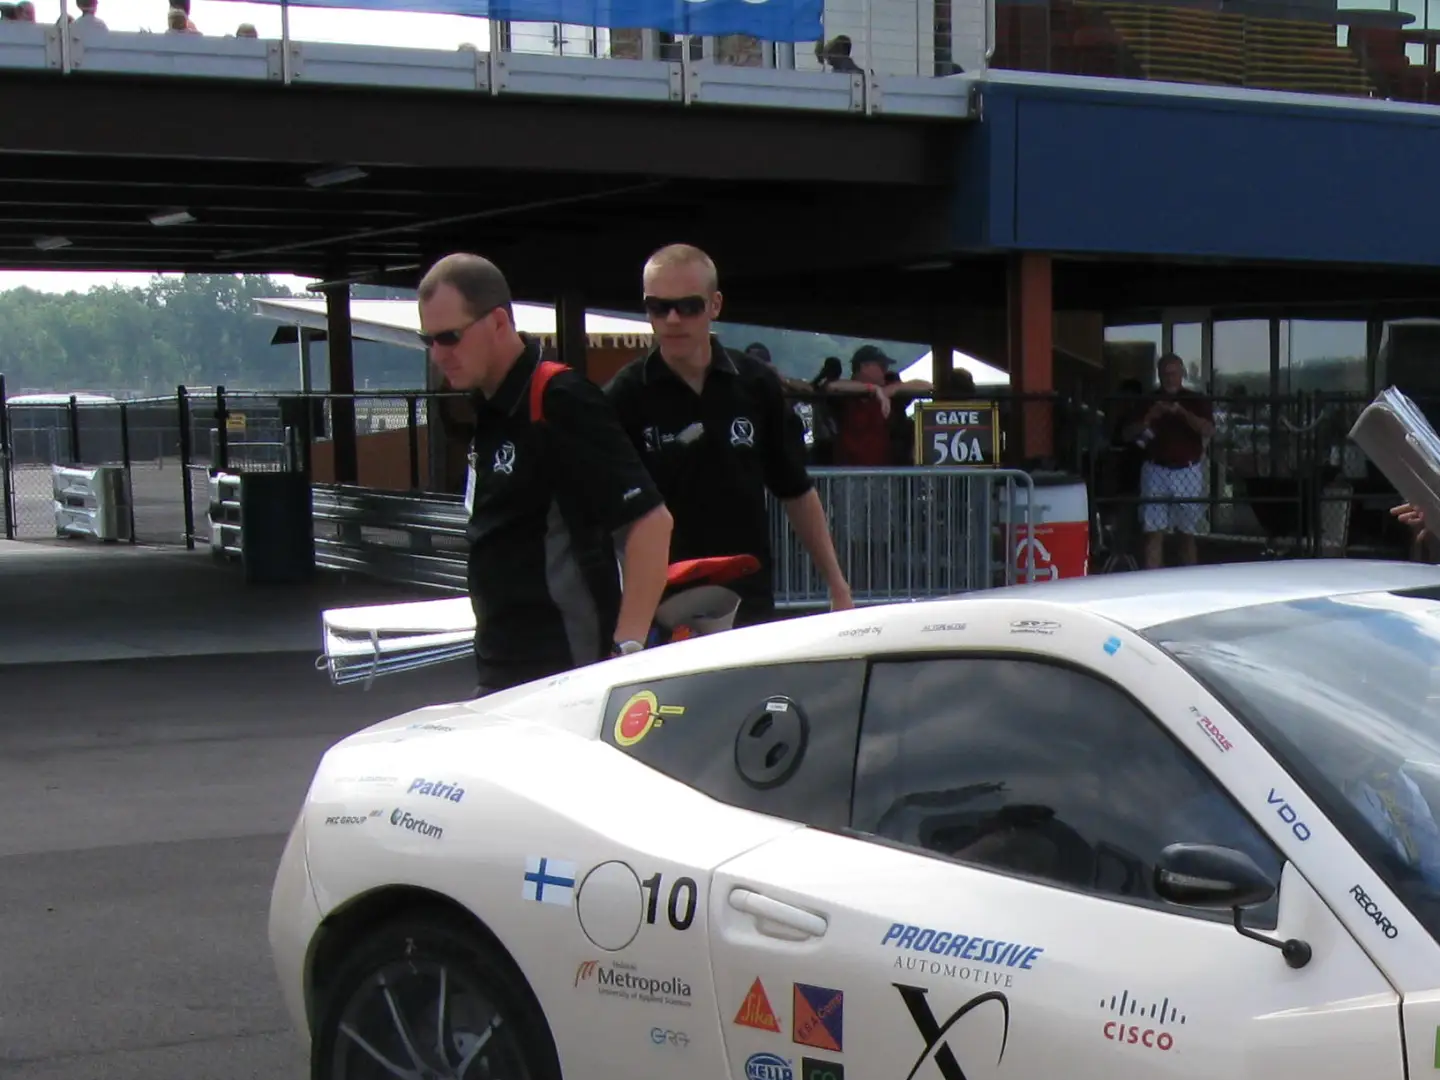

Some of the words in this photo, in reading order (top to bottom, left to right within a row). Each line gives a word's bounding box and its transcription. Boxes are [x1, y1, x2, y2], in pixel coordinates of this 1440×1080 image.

[935, 411, 979, 424] GATE
[934, 429, 984, 465] 56A
[407, 777, 466, 804] Patria
[399, 811, 444, 840] Fortum
[1266, 788, 1312, 843] VDO
[642, 872, 698, 931] 10
[1350, 884, 1398, 940] RECARO
[881, 923, 1044, 970] PROGRESSIVE
[597, 967, 692, 997] Metropolia
[893, 955, 1014, 988] AUTOMOTIVE
[743, 992, 774, 1026] Sika
